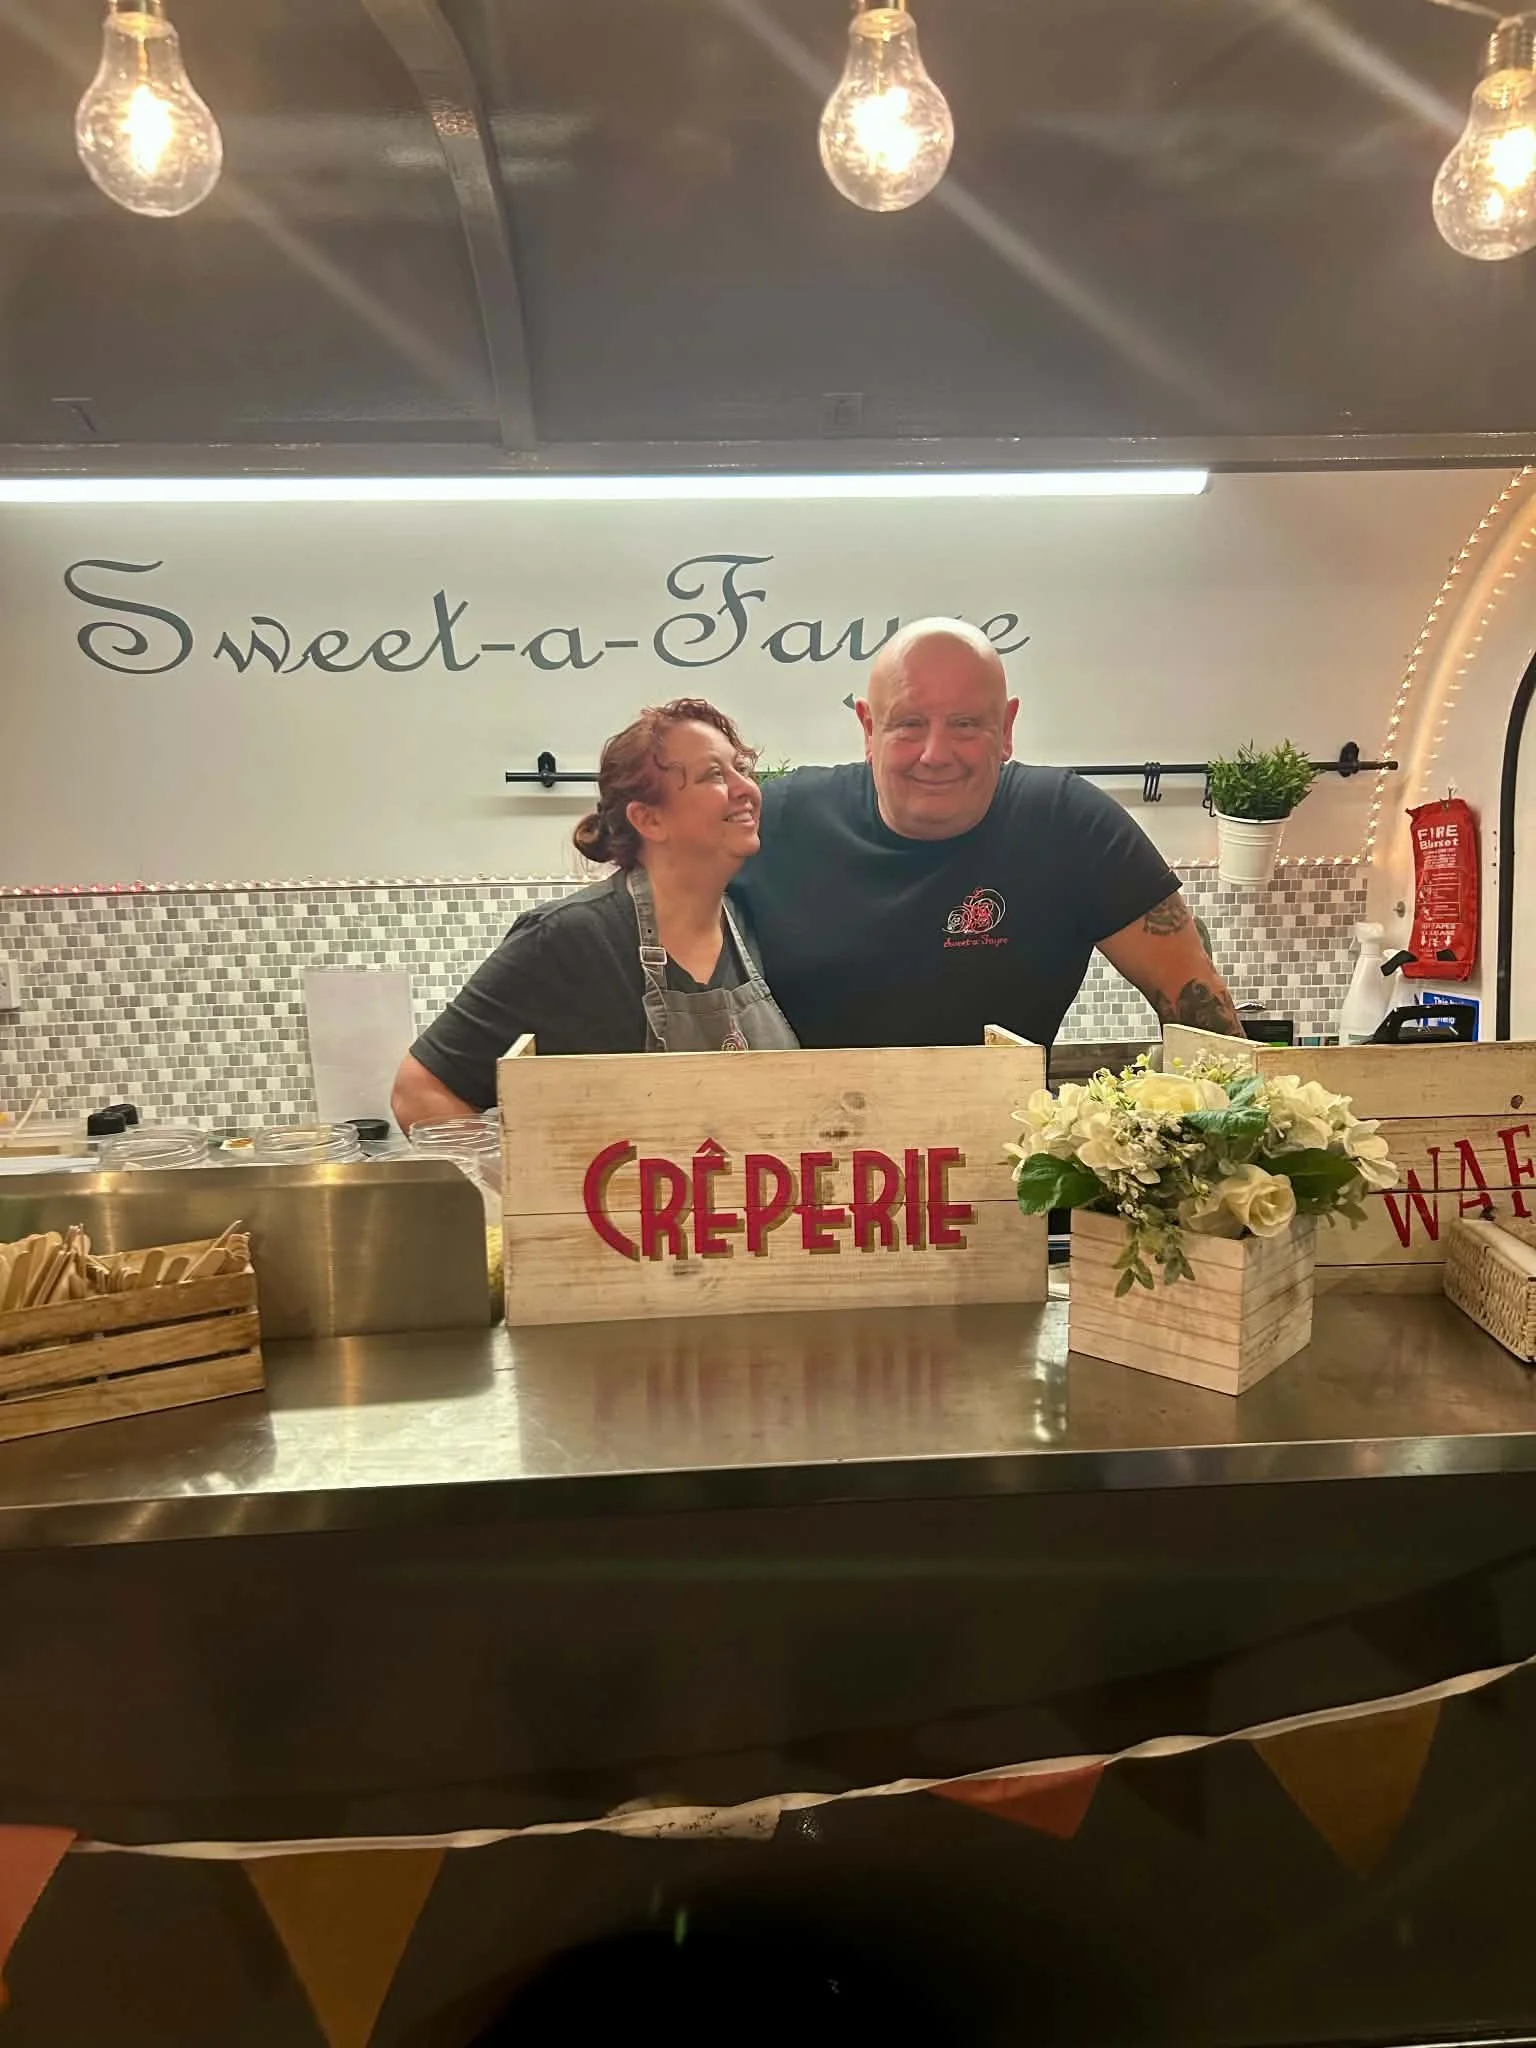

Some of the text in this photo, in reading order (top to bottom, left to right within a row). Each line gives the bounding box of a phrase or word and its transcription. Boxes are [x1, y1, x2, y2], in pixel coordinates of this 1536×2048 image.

[64, 553, 1030, 708] Sweet-a-Faye
[1417, 824, 1459, 841] FIRE
[583, 1137, 978, 1263] CRÊPERIE
